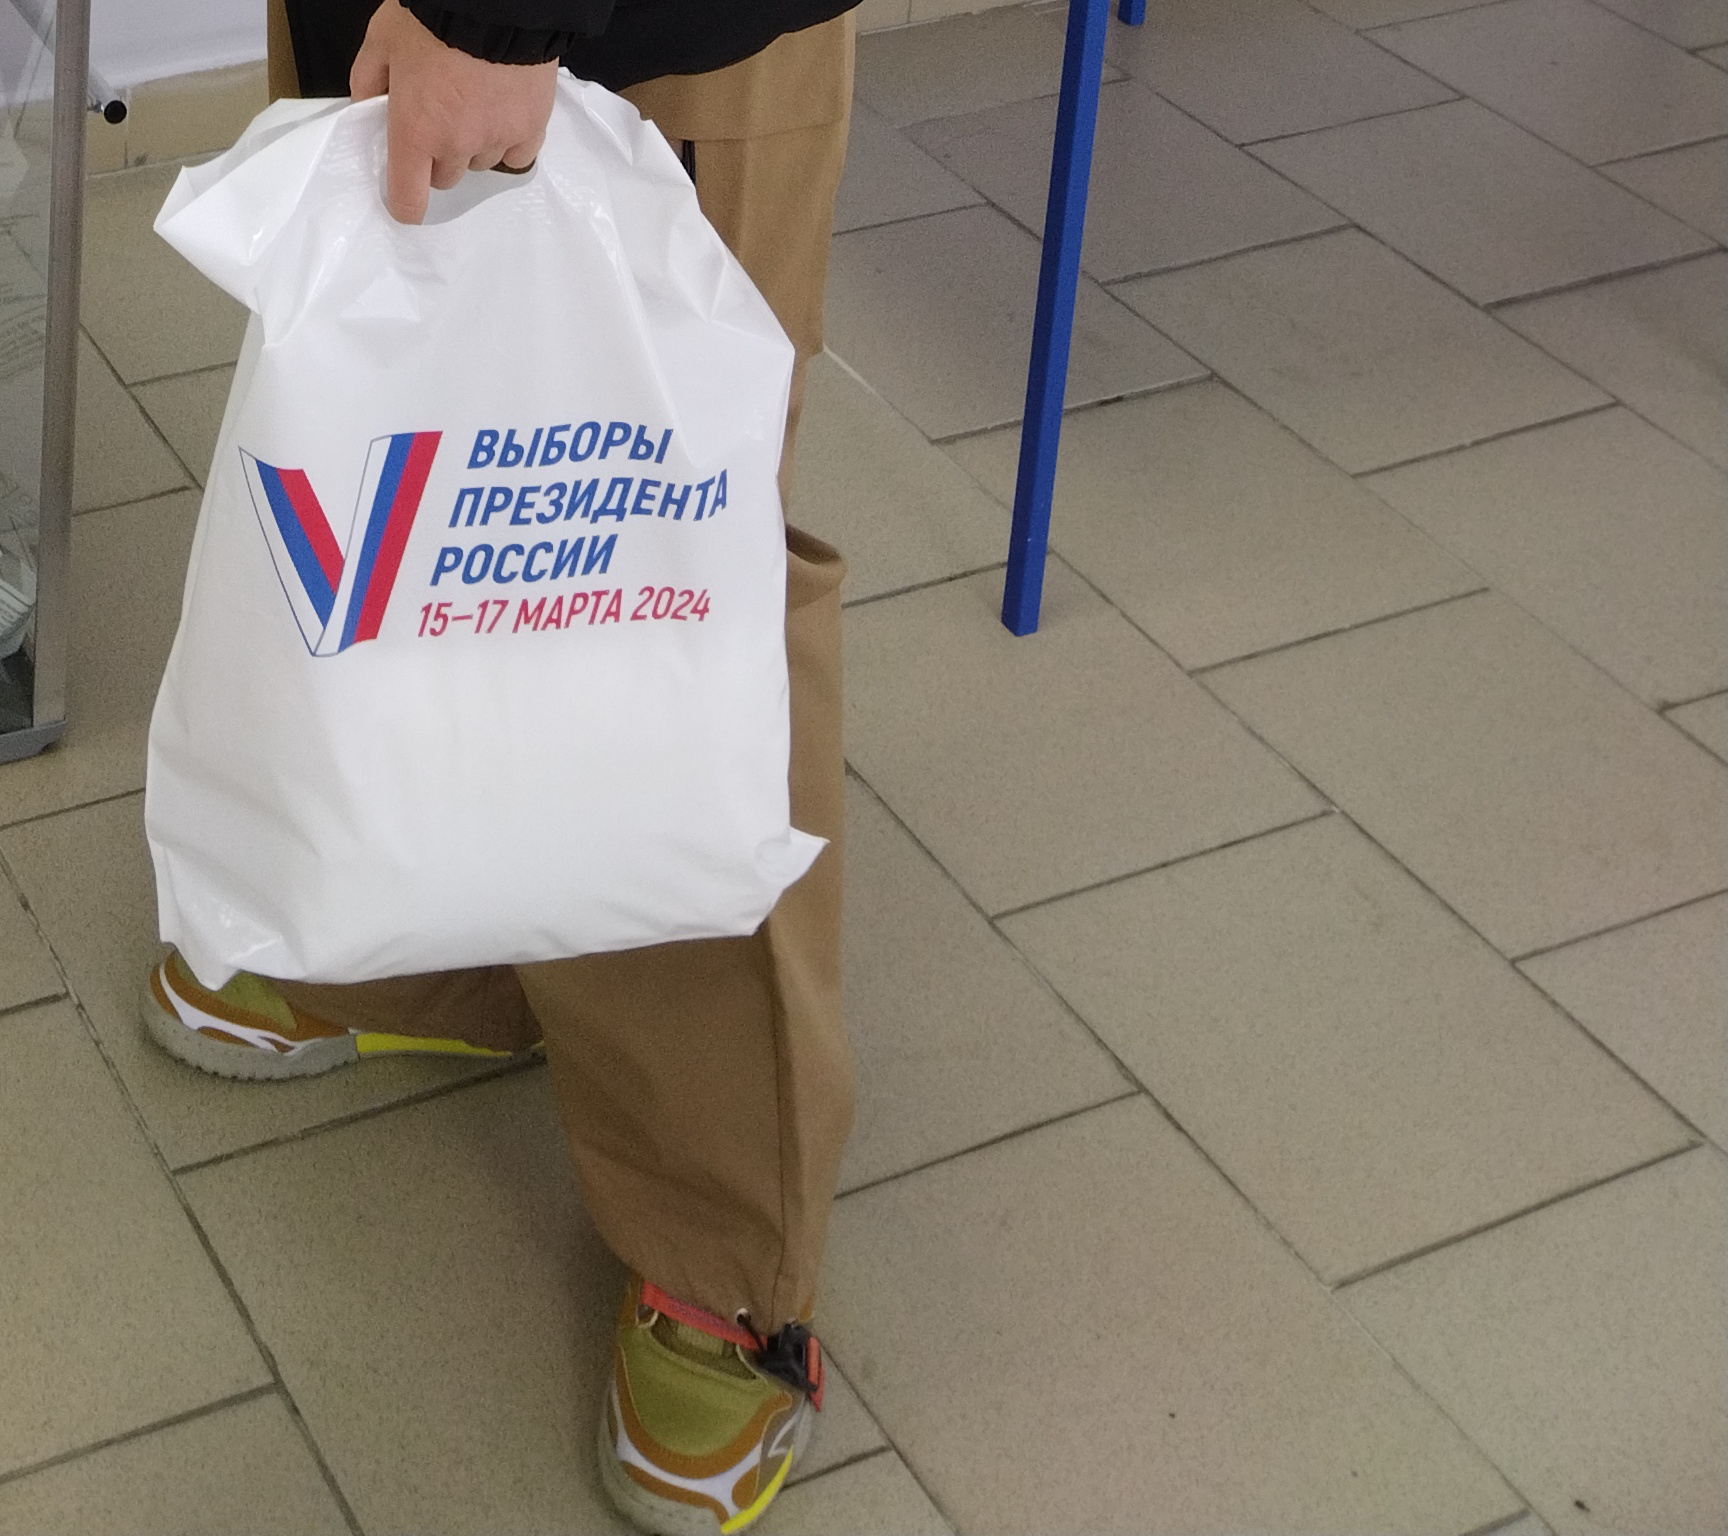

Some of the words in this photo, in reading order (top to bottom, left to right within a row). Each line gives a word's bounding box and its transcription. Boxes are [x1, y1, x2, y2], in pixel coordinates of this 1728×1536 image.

[467, 422, 673, 469] ВЫБОРЫ
[448, 469, 727, 528] ПРЕЗИДЕНТА
[430, 534, 618, 586] РОССИИ
[512, 589, 622, 633] МАРТА
[630, 586, 710, 621] 2024
